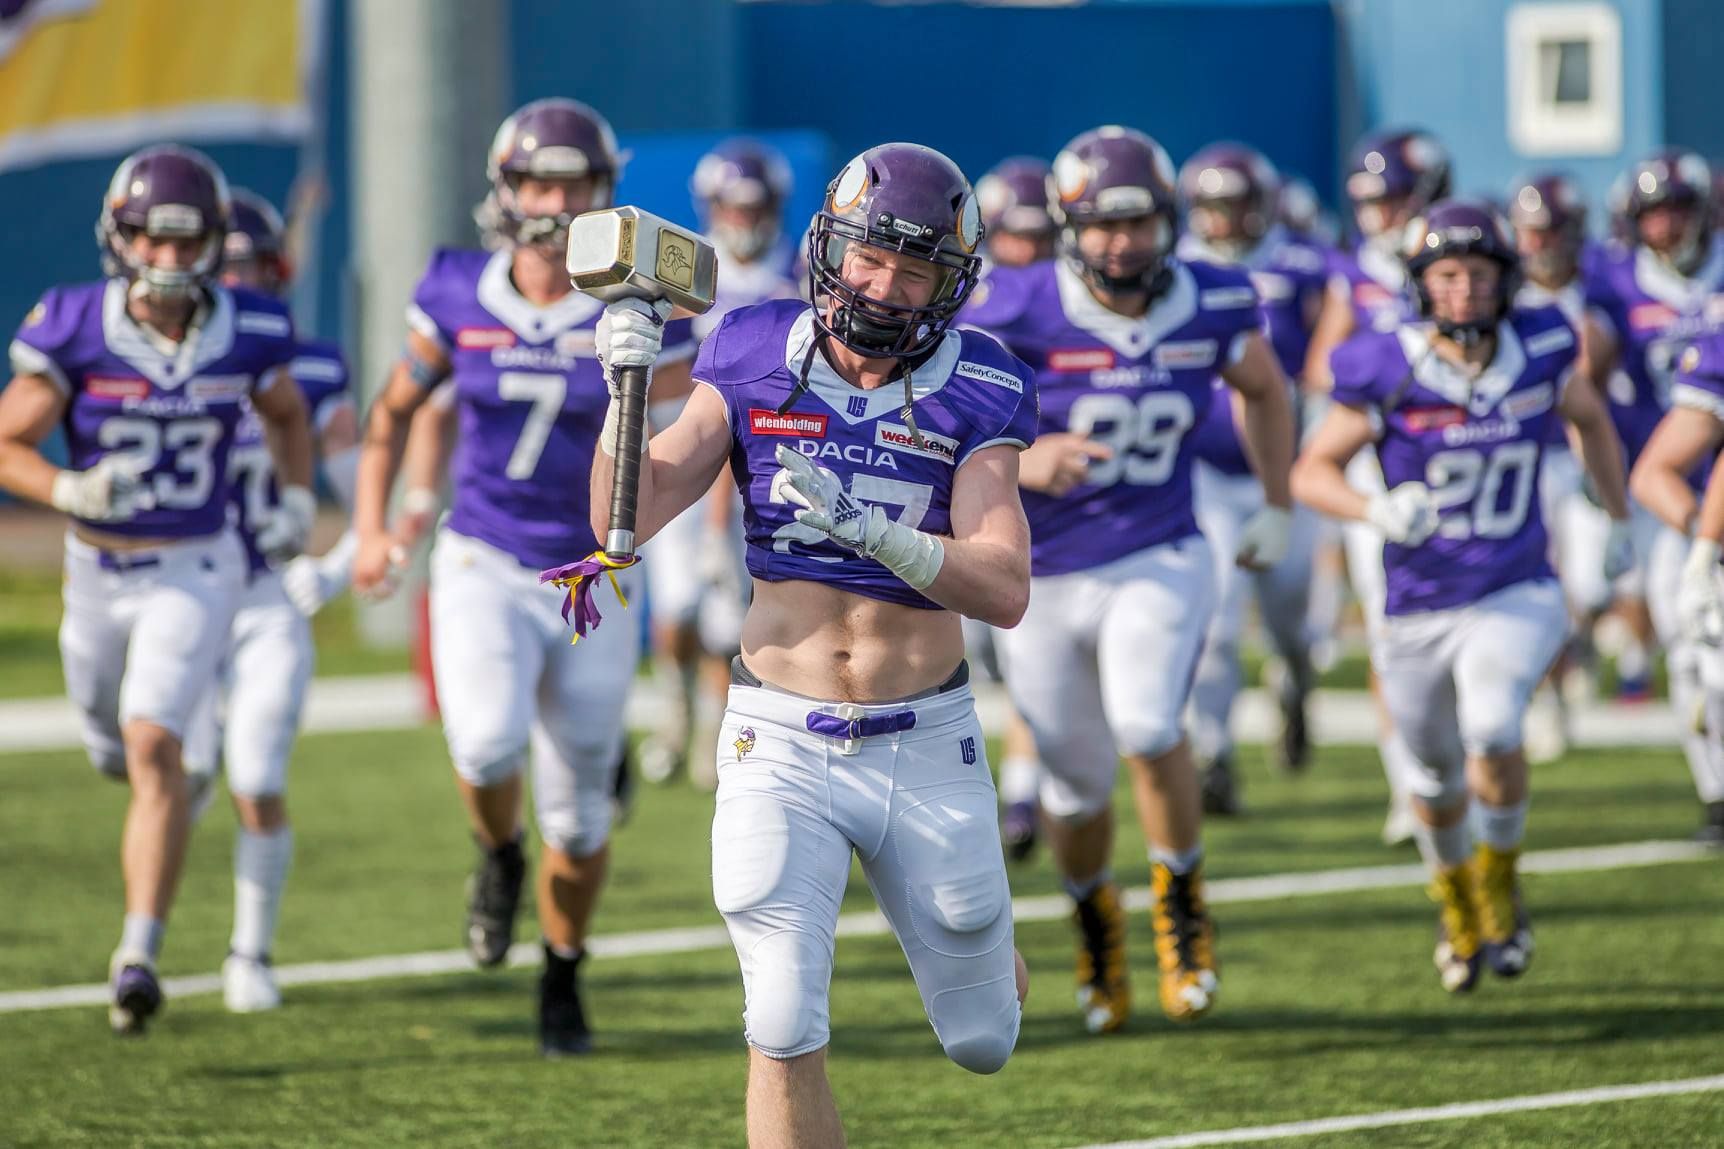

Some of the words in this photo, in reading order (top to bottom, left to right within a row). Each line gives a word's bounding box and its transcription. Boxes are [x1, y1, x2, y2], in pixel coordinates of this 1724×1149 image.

[895, 222, 919, 234] schutt
[960, 363, 1021, 389] SafetyConcepts
[497, 371, 567, 480] 7
[754, 416, 822, 433] wienholding
[99, 416, 223, 510] 23
[799, 440, 898, 470] DACIA
[1425, 440, 1538, 540] 20
